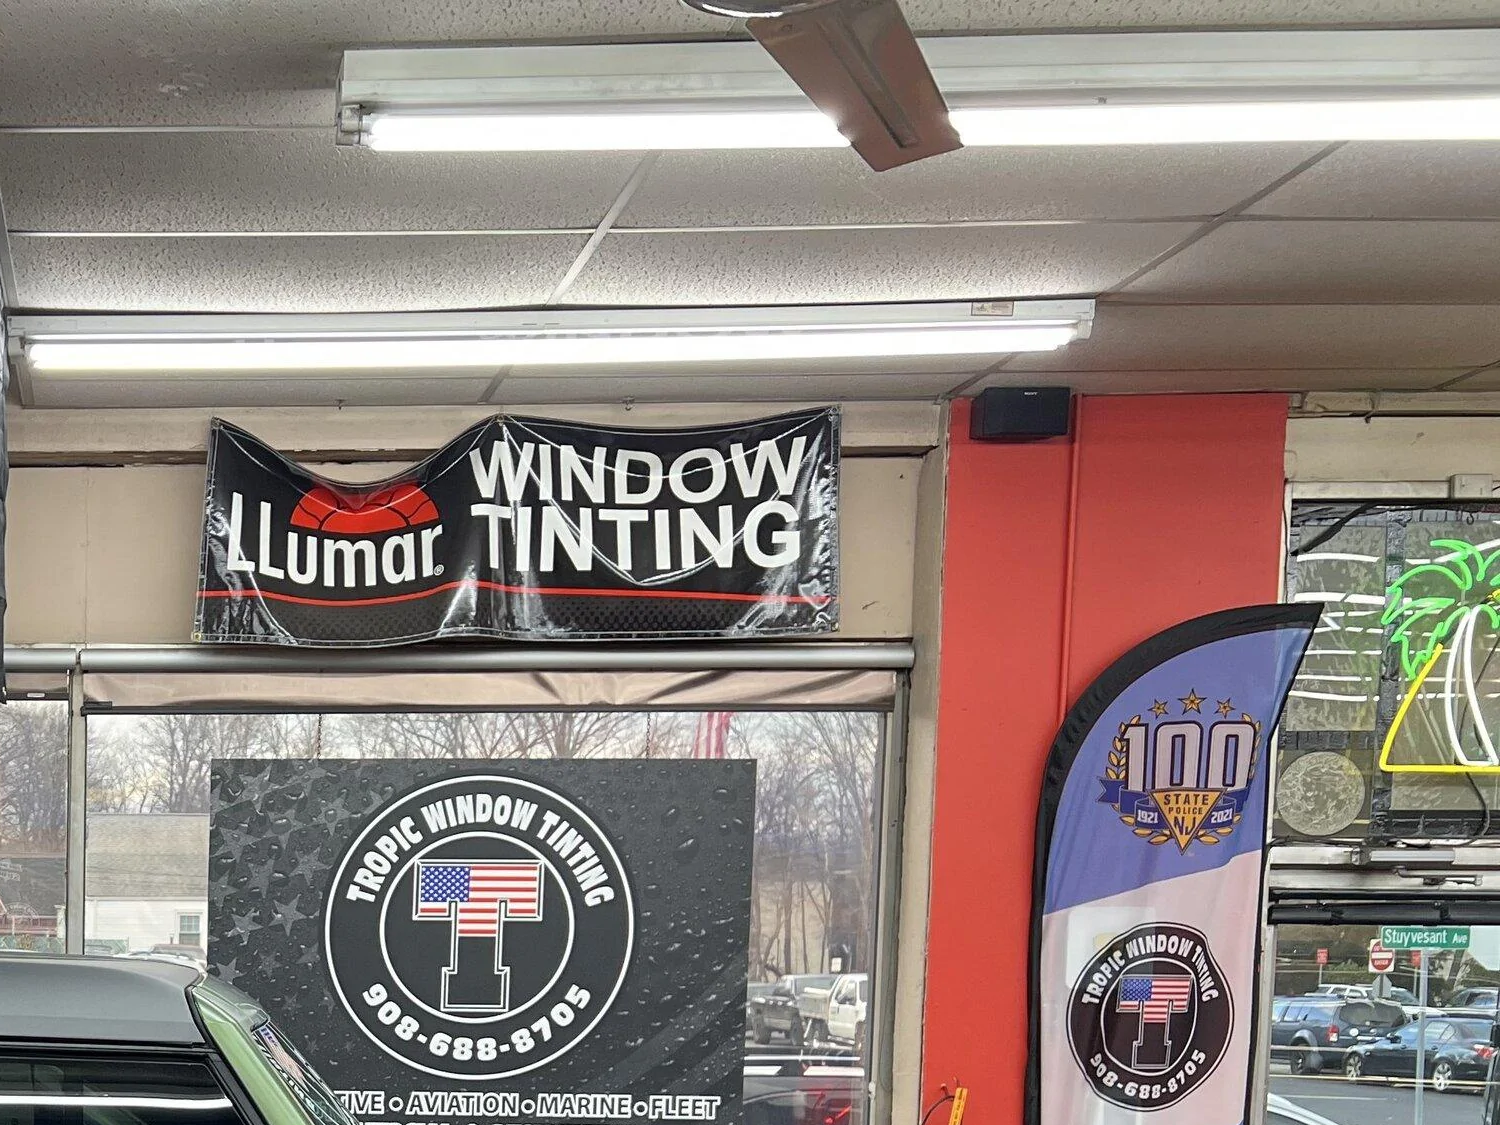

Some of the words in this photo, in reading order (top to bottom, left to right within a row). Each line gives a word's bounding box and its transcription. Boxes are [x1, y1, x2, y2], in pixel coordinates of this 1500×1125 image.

[468, 434, 807, 506] WINDOW
[470, 501, 805, 573] TINTING
[1122, 720, 1256, 791] 100
[1136, 809, 1159, 824] 1921
[1163, 793, 1209, 806] STATE
[1168, 806, 1204, 815] POLICE
[1210, 807, 1233, 824] 2021
[1173, 816, 1197, 836] NJ
[345, 815, 424, 903] TROPIC
[420, 793, 538, 834] WINDOW
[535, 809, 615, 908] TINTING
[1384, 928, 1448, 947] Stuyvesant
[1452, 933, 1468, 944] Ave
[1081, 950, 1126, 1005] TROPIC
[1125, 934, 1194, 959] WINDOW
[362, 982, 592, 1062] 908-688-8705
[1090, 1049, 1207, 1100] 908-688-8705
[405, 1091, 520, 1117] AVIATION
[536, 1093, 632, 1119] MARINE
[648, 1095, 722, 1120] FLEET
